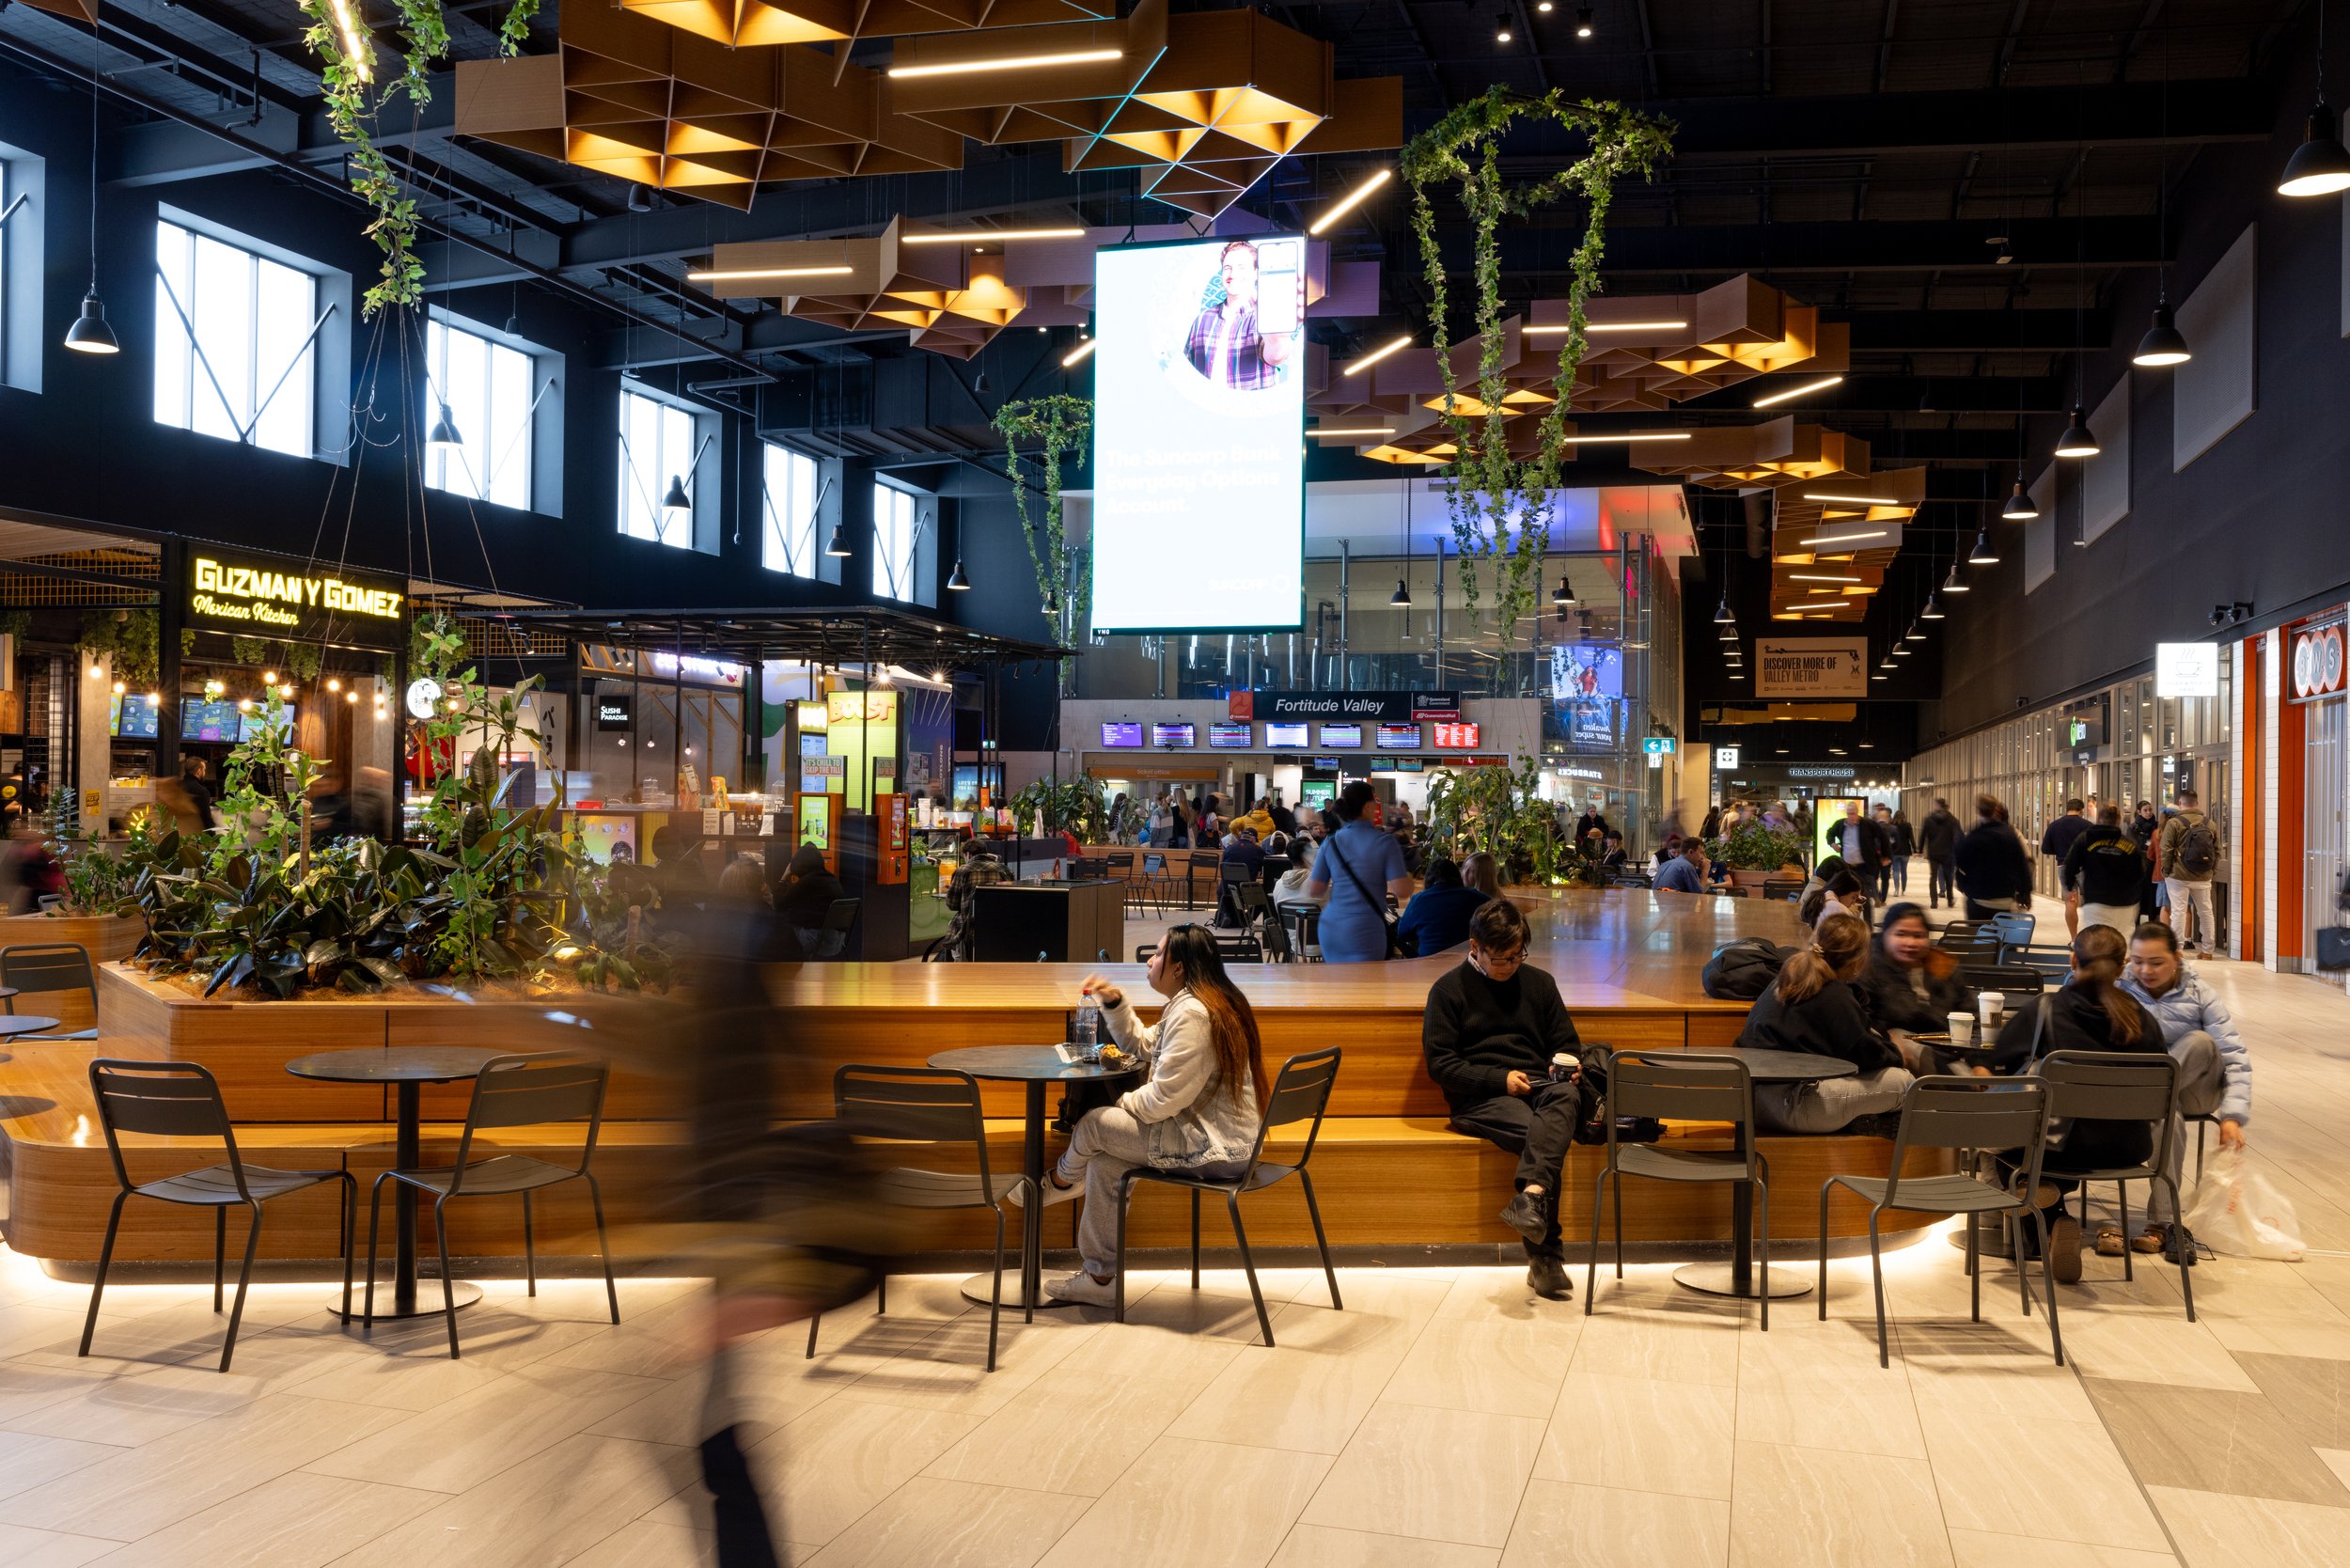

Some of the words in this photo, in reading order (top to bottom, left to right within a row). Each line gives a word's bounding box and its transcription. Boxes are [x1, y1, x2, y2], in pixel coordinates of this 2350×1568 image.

[1105, 450, 1141, 466] The
[1144, 447, 1226, 467] Suncorp
[1231, 444, 1282, 462] Bank
[1105, 472, 1196, 493] Everyday
[1200, 469, 1279, 490] Options
[323, 578, 400, 619] GOMEZ
[193, 594, 251, 619] Mexican
[252, 602, 299, 626] Kitchen
[1763, 657, 1801, 670] DISCOVER
[1803, 656, 1825, 669] MORE
[1826, 656, 1837, 669] OF
[1763, 669, 1791, 682] VALLEY
[1793, 669, 1819, 682] METRO
[601, 706, 621, 714] SUSHI
[828, 698, 895, 722] BOOST
[1276, 698, 1339, 712] Fortitude
[1343, 698, 1385, 714] Valley
[805, 766, 818, 775] SKIP
[820, 766, 829, 775] THE
[830, 766, 841, 775] TILL
